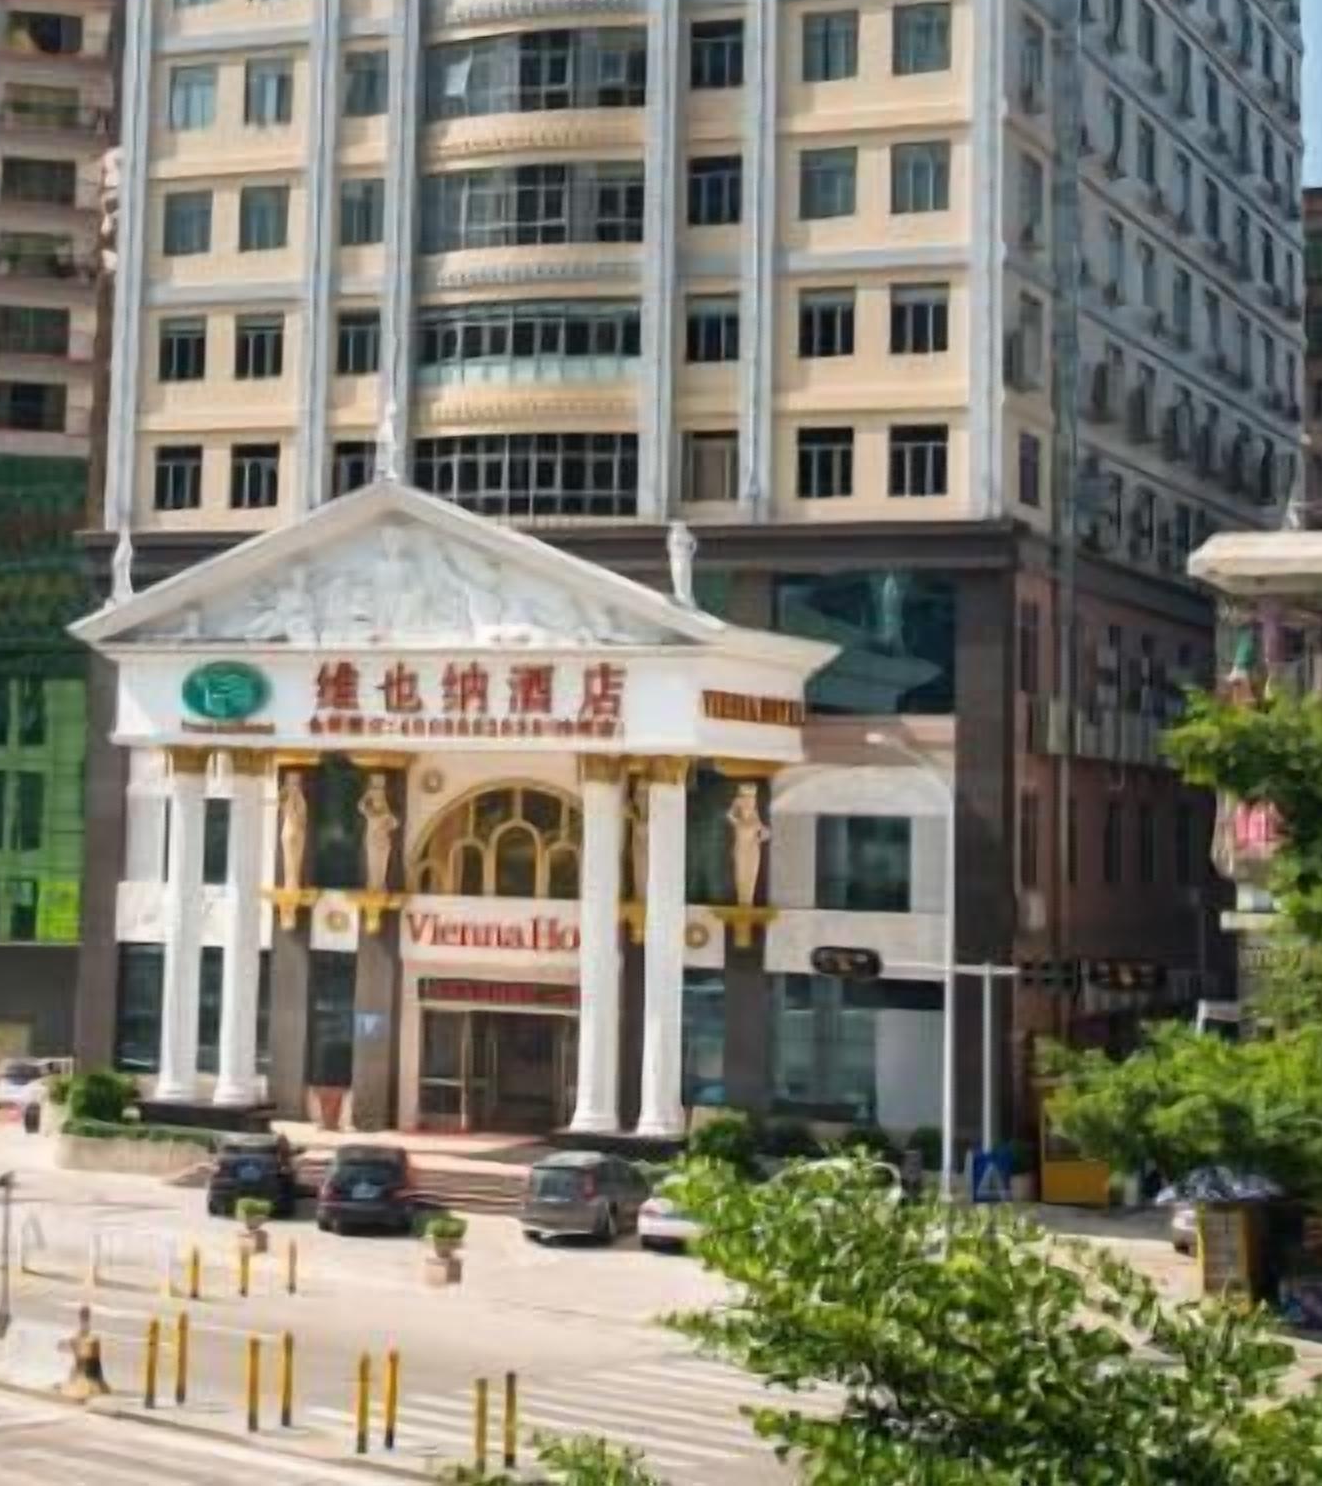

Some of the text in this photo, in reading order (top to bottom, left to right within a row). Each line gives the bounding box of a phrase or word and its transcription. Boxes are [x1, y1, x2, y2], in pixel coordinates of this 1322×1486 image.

[315, 660, 627, 718] 维也纳酒店
[407, 913, 526, 948] Vienna
